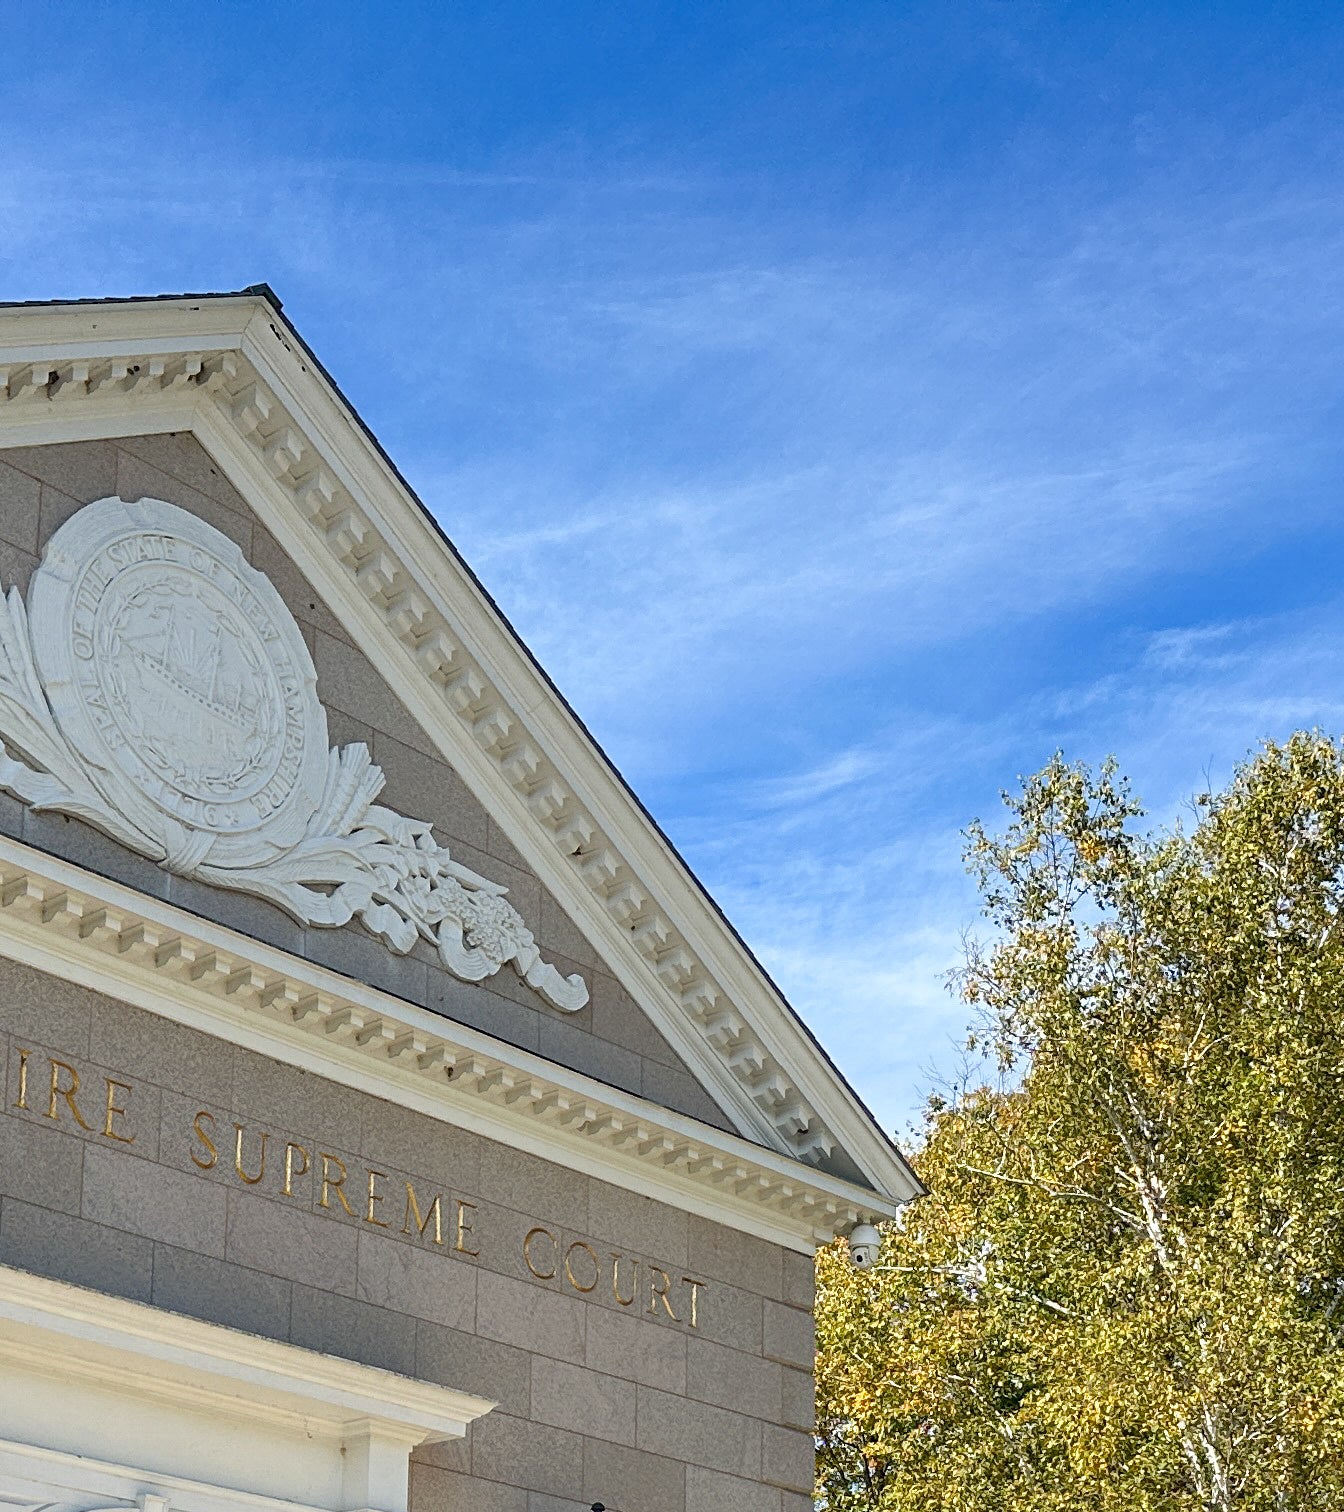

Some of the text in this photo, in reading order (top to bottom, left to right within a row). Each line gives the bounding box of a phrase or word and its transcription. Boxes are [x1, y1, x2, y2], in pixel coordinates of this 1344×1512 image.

[106, 538, 176, 570] STATE
[190, 550, 221, 580] OF
[76, 560, 112, 614] THE
[231, 581, 281, 641] NEW
[73, 622, 94, 660] OF
[250, 656, 305, 820] HAMPSHIRE
[190, 1110, 480, 1257] SUPREME
[523, 1227, 707, 1328] COURT
